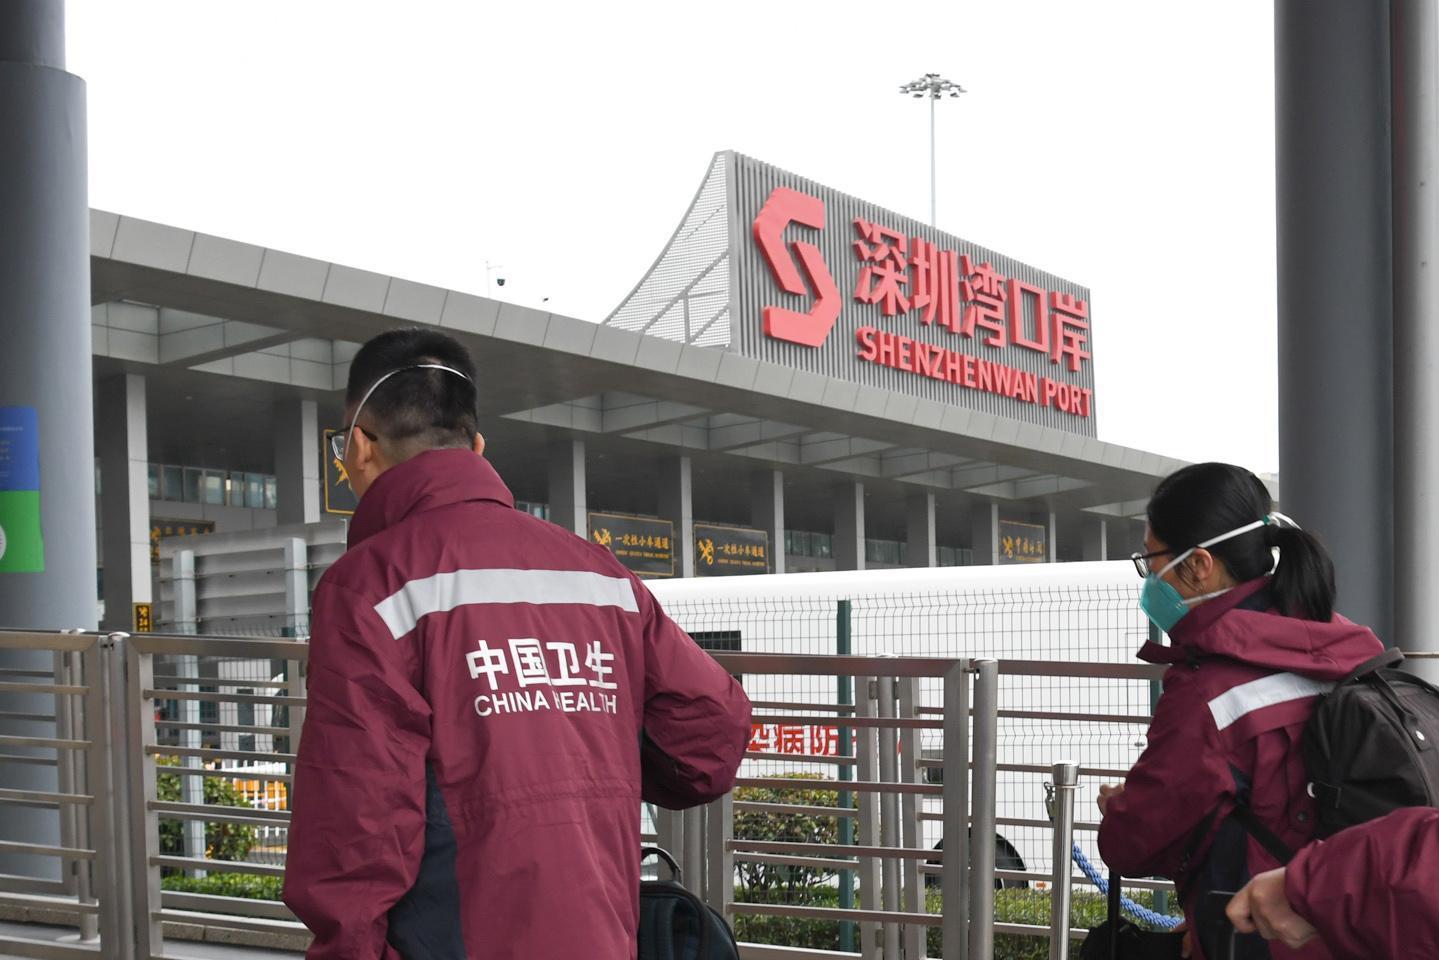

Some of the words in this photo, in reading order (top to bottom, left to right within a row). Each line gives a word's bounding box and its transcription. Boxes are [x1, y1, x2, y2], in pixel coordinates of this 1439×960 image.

[853, 216, 1091, 372] 深圳湾口岸
[856, 326, 1038, 403] SHENZHENWAN
[1041, 376, 1093, 417] PORT
[465, 638, 618, 691] 中国卫生
[474, 690, 550, 717] CHINA
